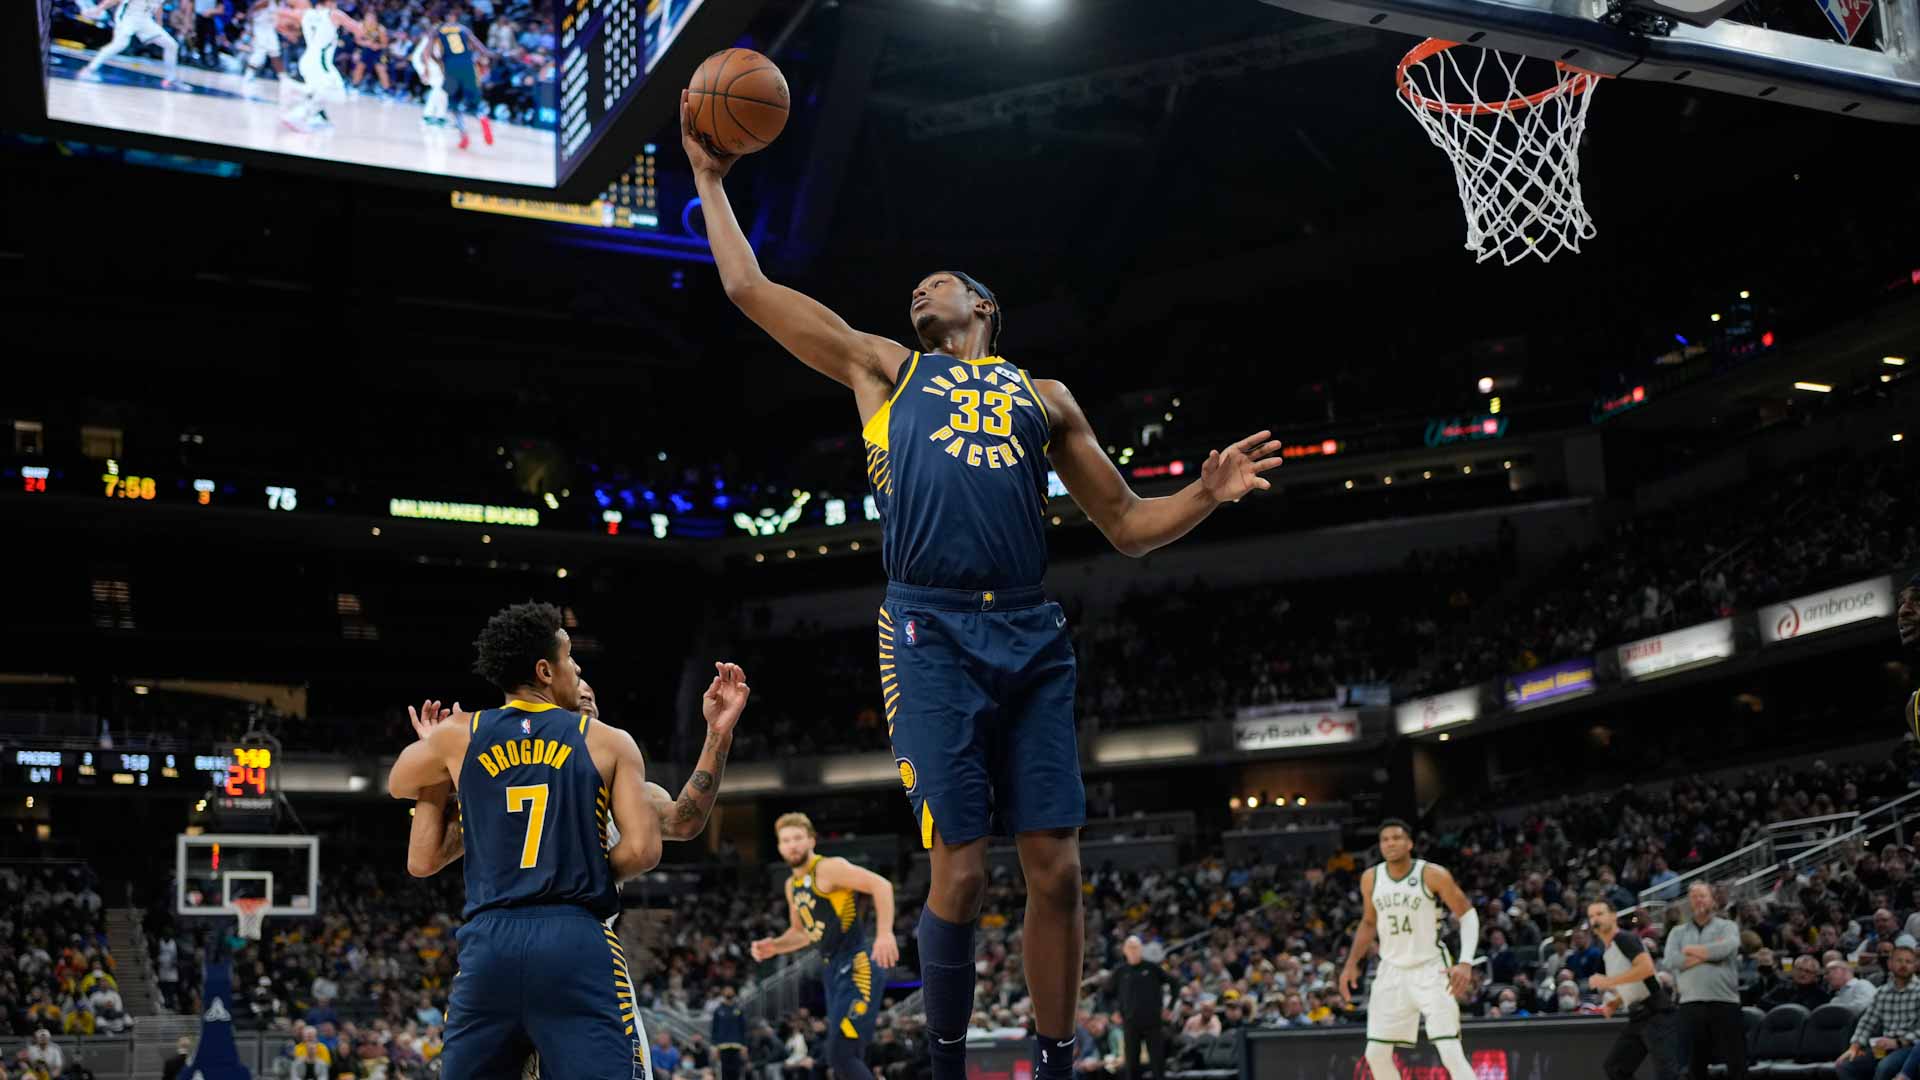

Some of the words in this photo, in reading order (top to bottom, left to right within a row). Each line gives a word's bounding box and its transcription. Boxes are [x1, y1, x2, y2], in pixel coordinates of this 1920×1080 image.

[950, 388, 1013, 437] 33
[928, 424, 1026, 469] PACERS
[102, 473, 156, 500] 7:58
[390, 498, 483, 523] MILWAUKEE
[1235, 721, 1311, 742] KeyBank
[478, 738, 572, 778] BROGDON
[225, 765, 267, 796] 24
[506, 783, 549, 869] 7
[1375, 892, 1422, 911] BUCKS
[1387, 914, 1413, 936] 34
